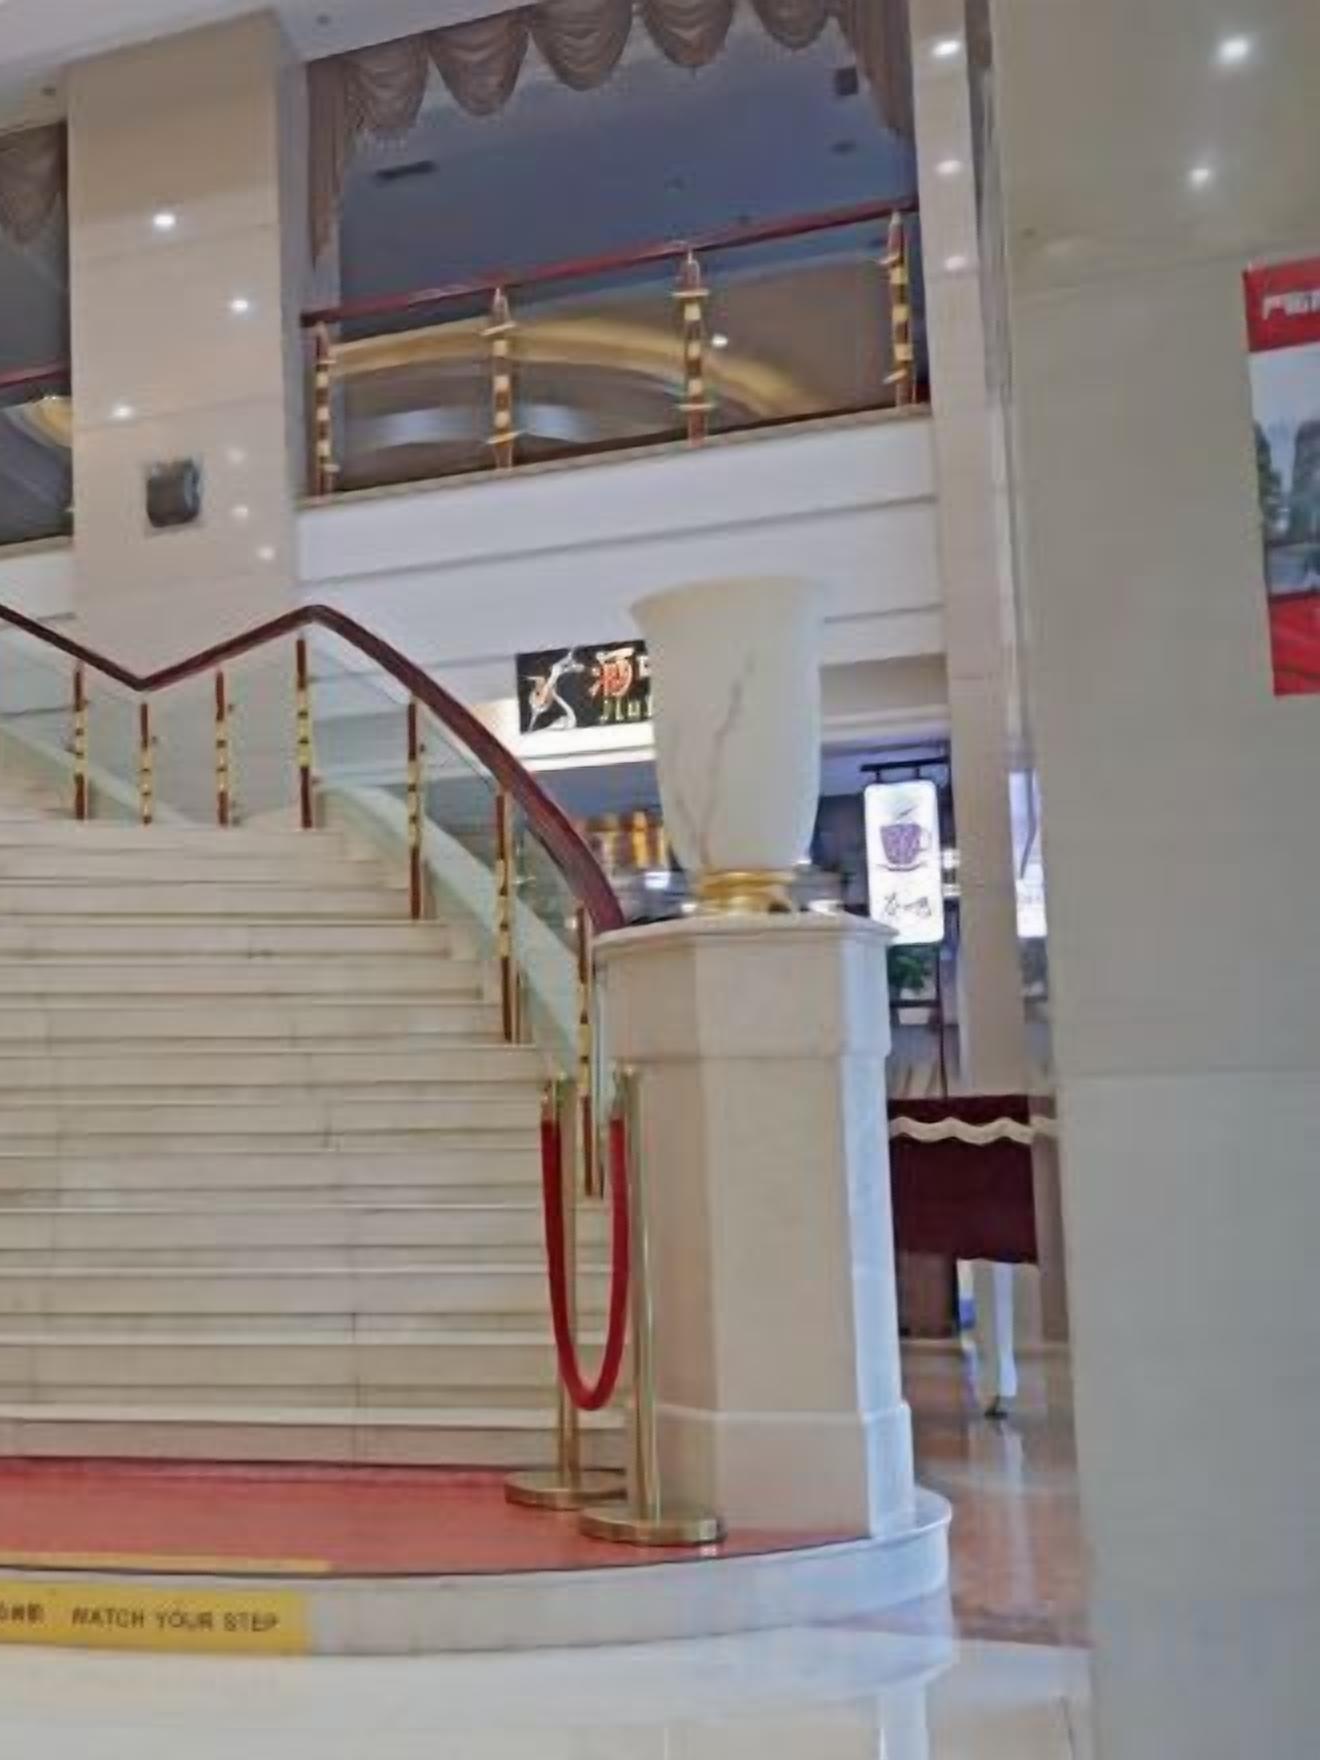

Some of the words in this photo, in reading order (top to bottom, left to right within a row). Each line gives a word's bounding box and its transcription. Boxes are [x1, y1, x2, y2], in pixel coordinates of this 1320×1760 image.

[71, 1607, 145, 1629] WATCH
[155, 1610, 214, 1631] YOUR
[223, 1611, 279, 1632] STEP
